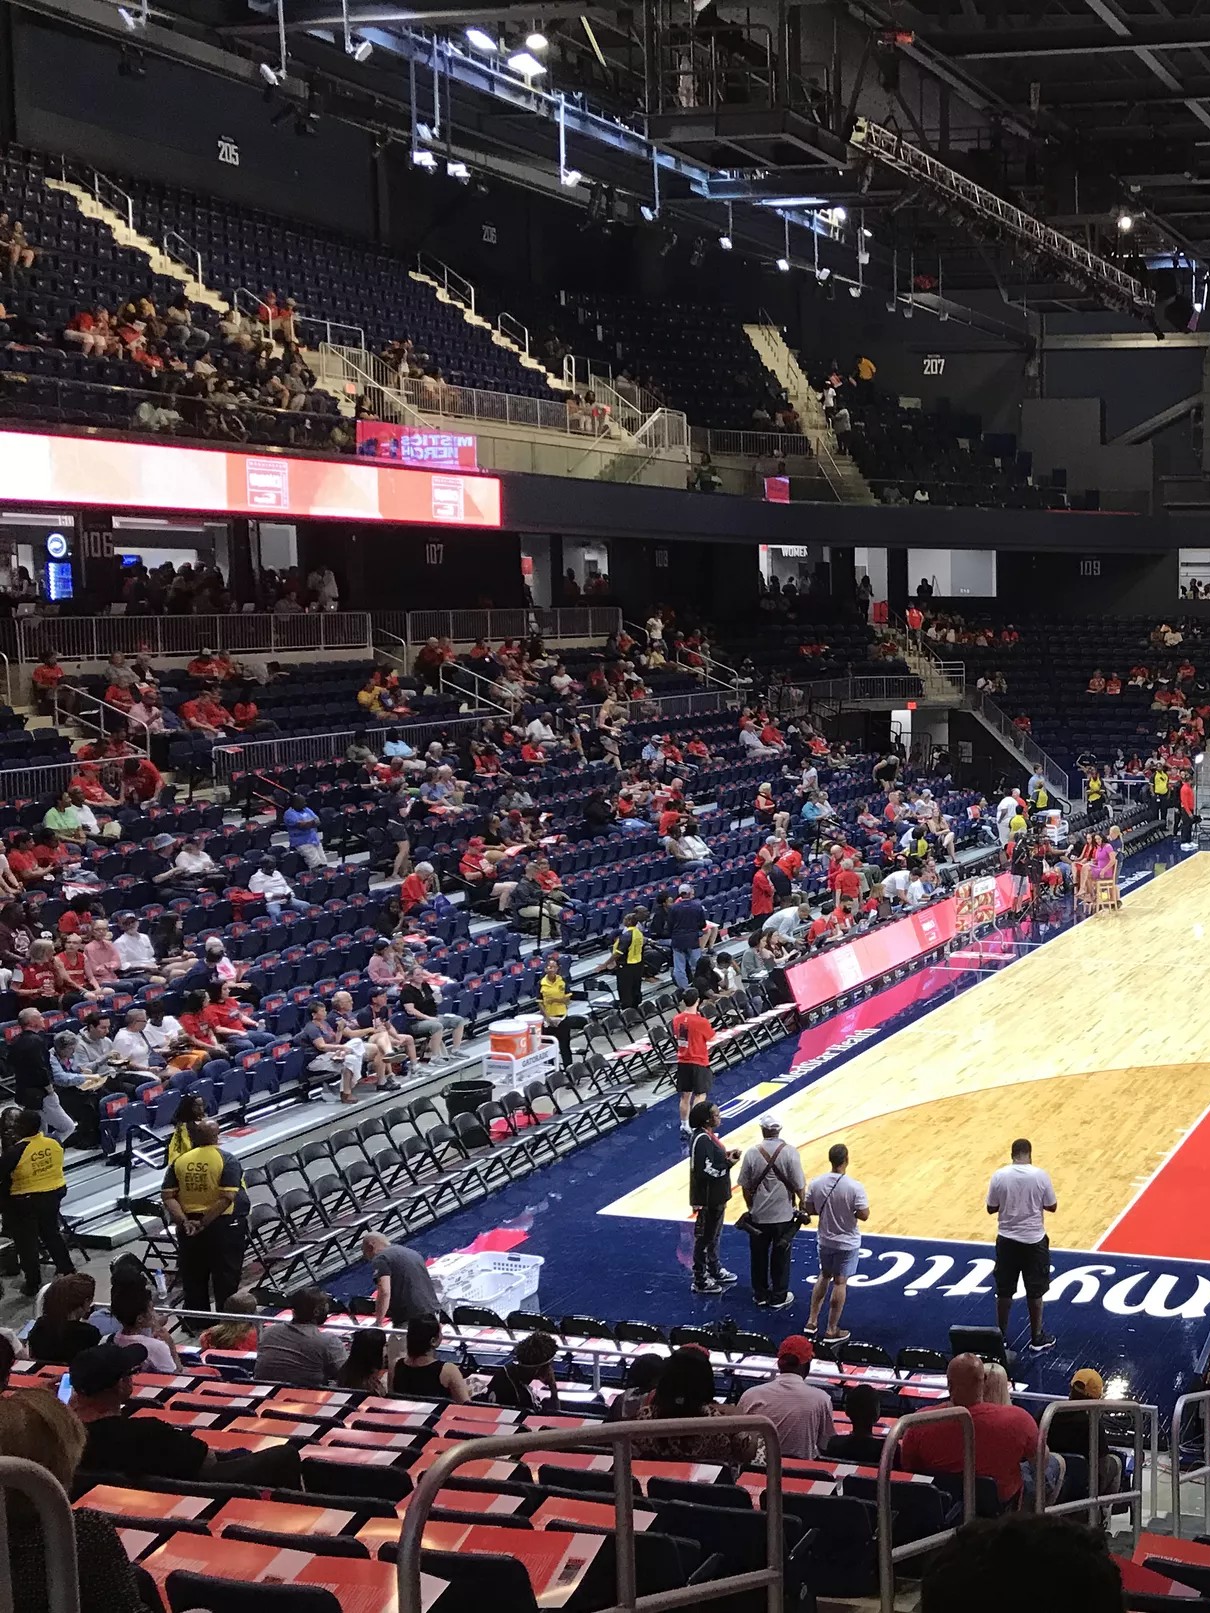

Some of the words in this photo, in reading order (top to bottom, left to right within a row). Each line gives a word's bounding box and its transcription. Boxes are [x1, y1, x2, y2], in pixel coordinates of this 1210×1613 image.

[218, 140, 239, 166] 205
[923, 358, 945, 375] 207
[83, 531, 114, 558] 106
[426, 544, 443, 564] 107
[1080, 560, 1101, 576] 109
[771, 1049, 832, 1084] MedStar
[828, 1027, 882, 1057] Health
[31, 1148, 51, 1161] CSC
[187, 1162, 208, 1173] CSC
[185, 1172, 207, 1183] EVENT
[186, 1183, 208, 1193] STAFF
